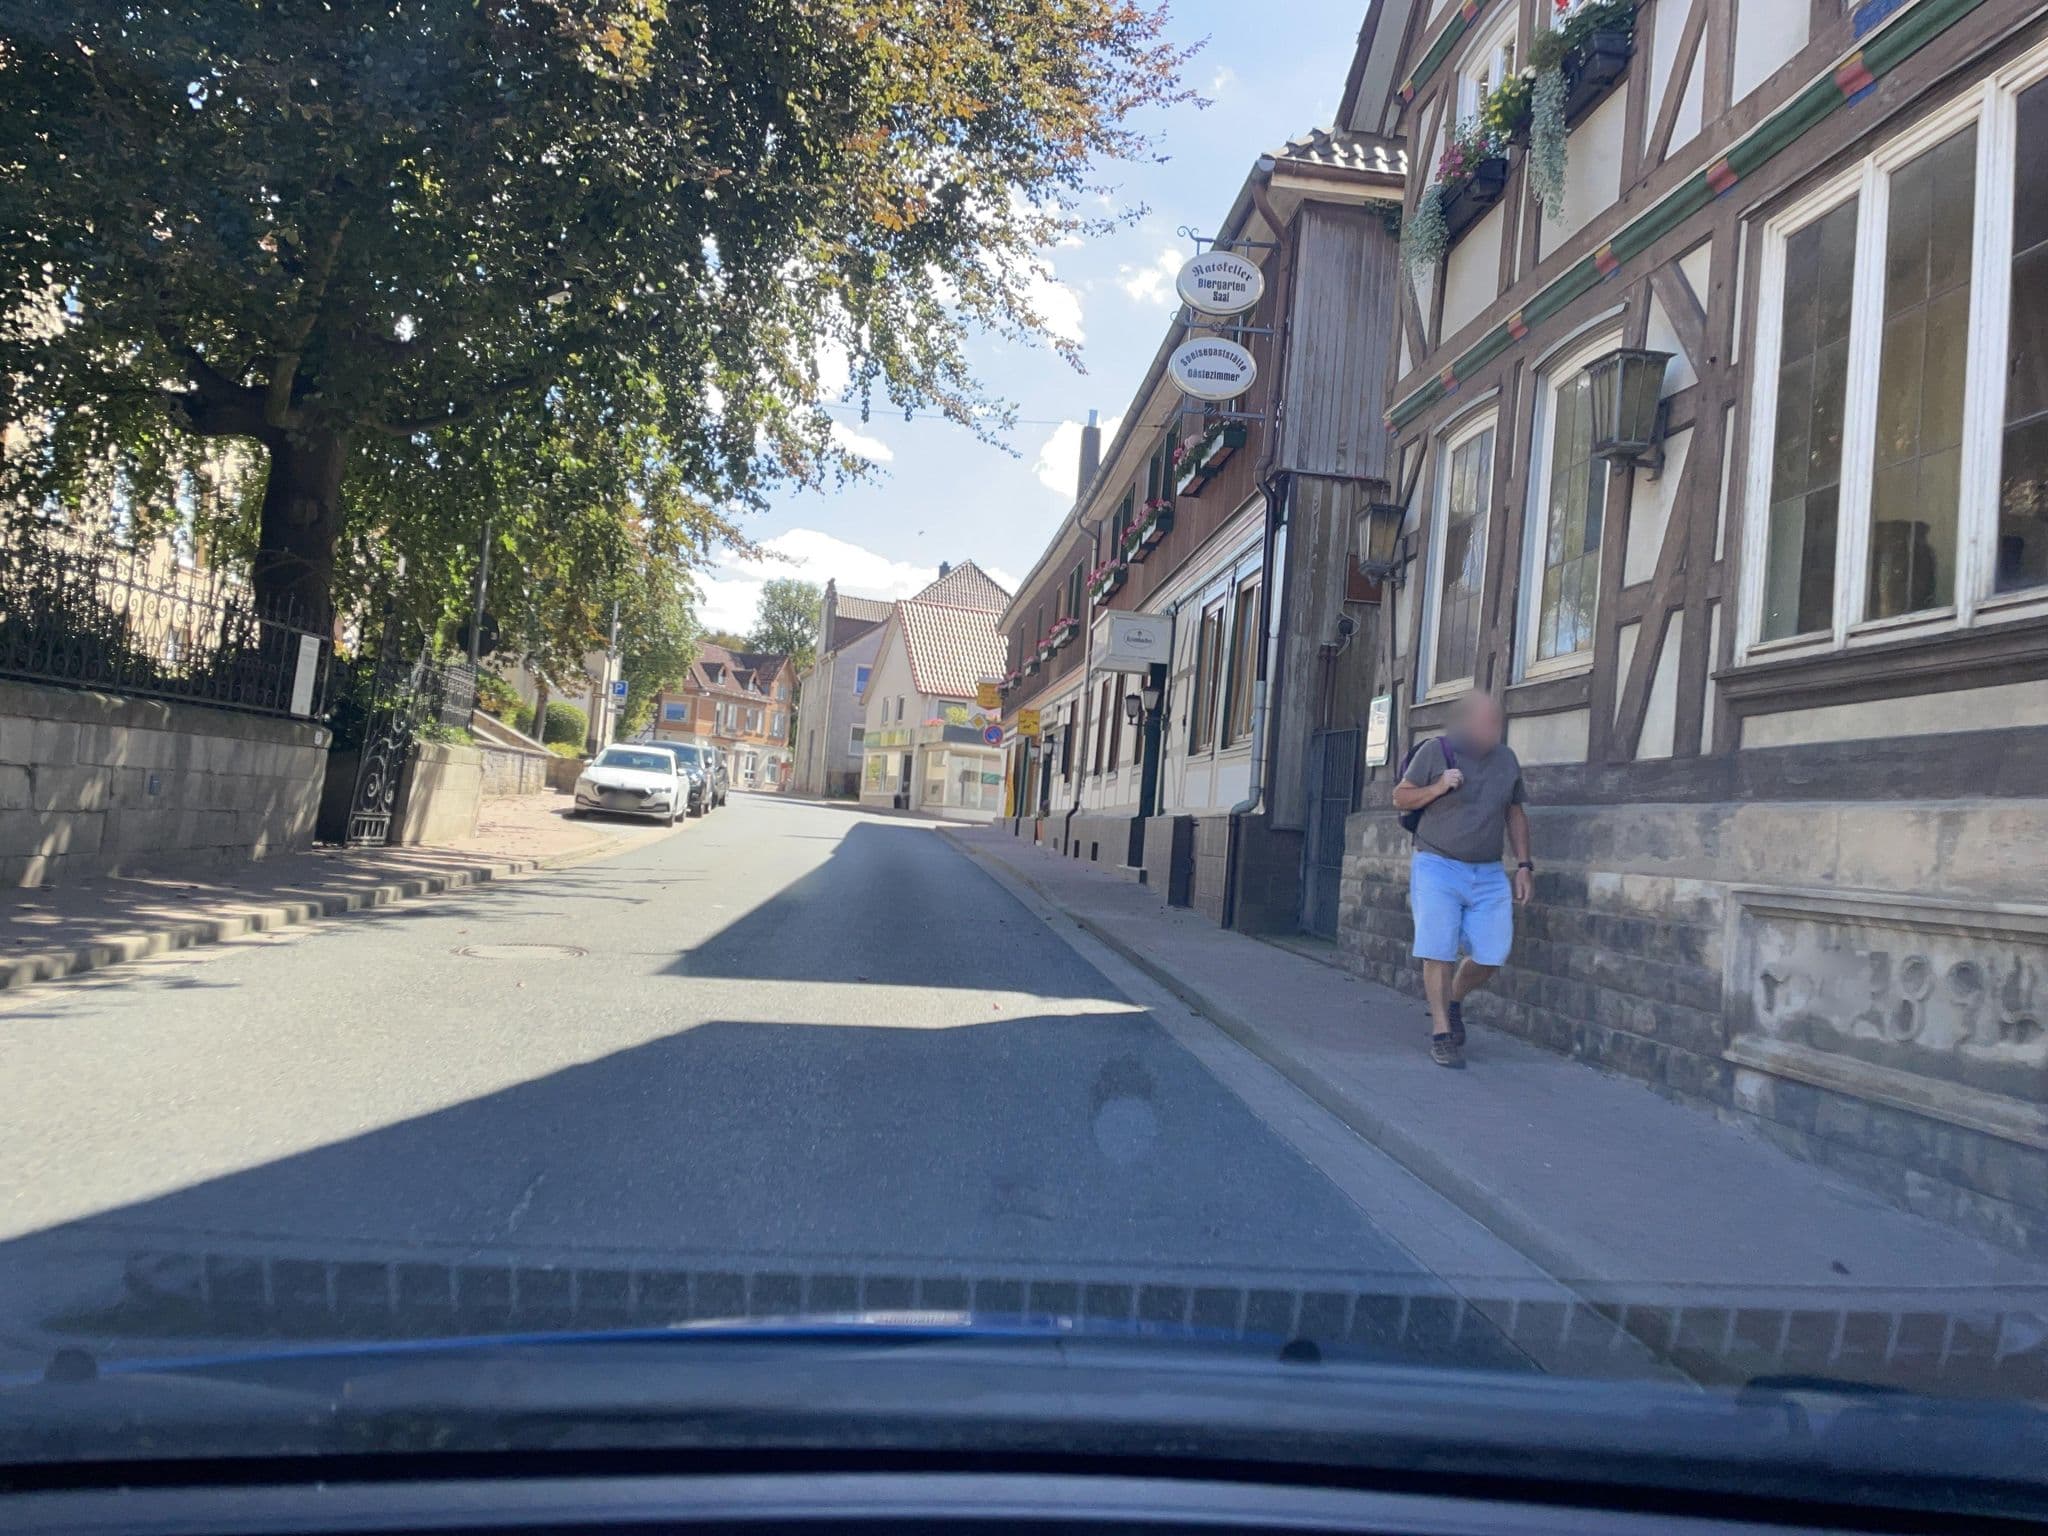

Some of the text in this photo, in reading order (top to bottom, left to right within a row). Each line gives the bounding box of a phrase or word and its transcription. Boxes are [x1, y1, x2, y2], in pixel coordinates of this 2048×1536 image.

[1192, 262, 1253, 281] Ratskeller
[1198, 278, 1246, 292] Biergarten
[1213, 291, 1230, 302] Saal
[1188, 368, 1240, 382] Gästezimmer
[614, 683, 624, 694] P
